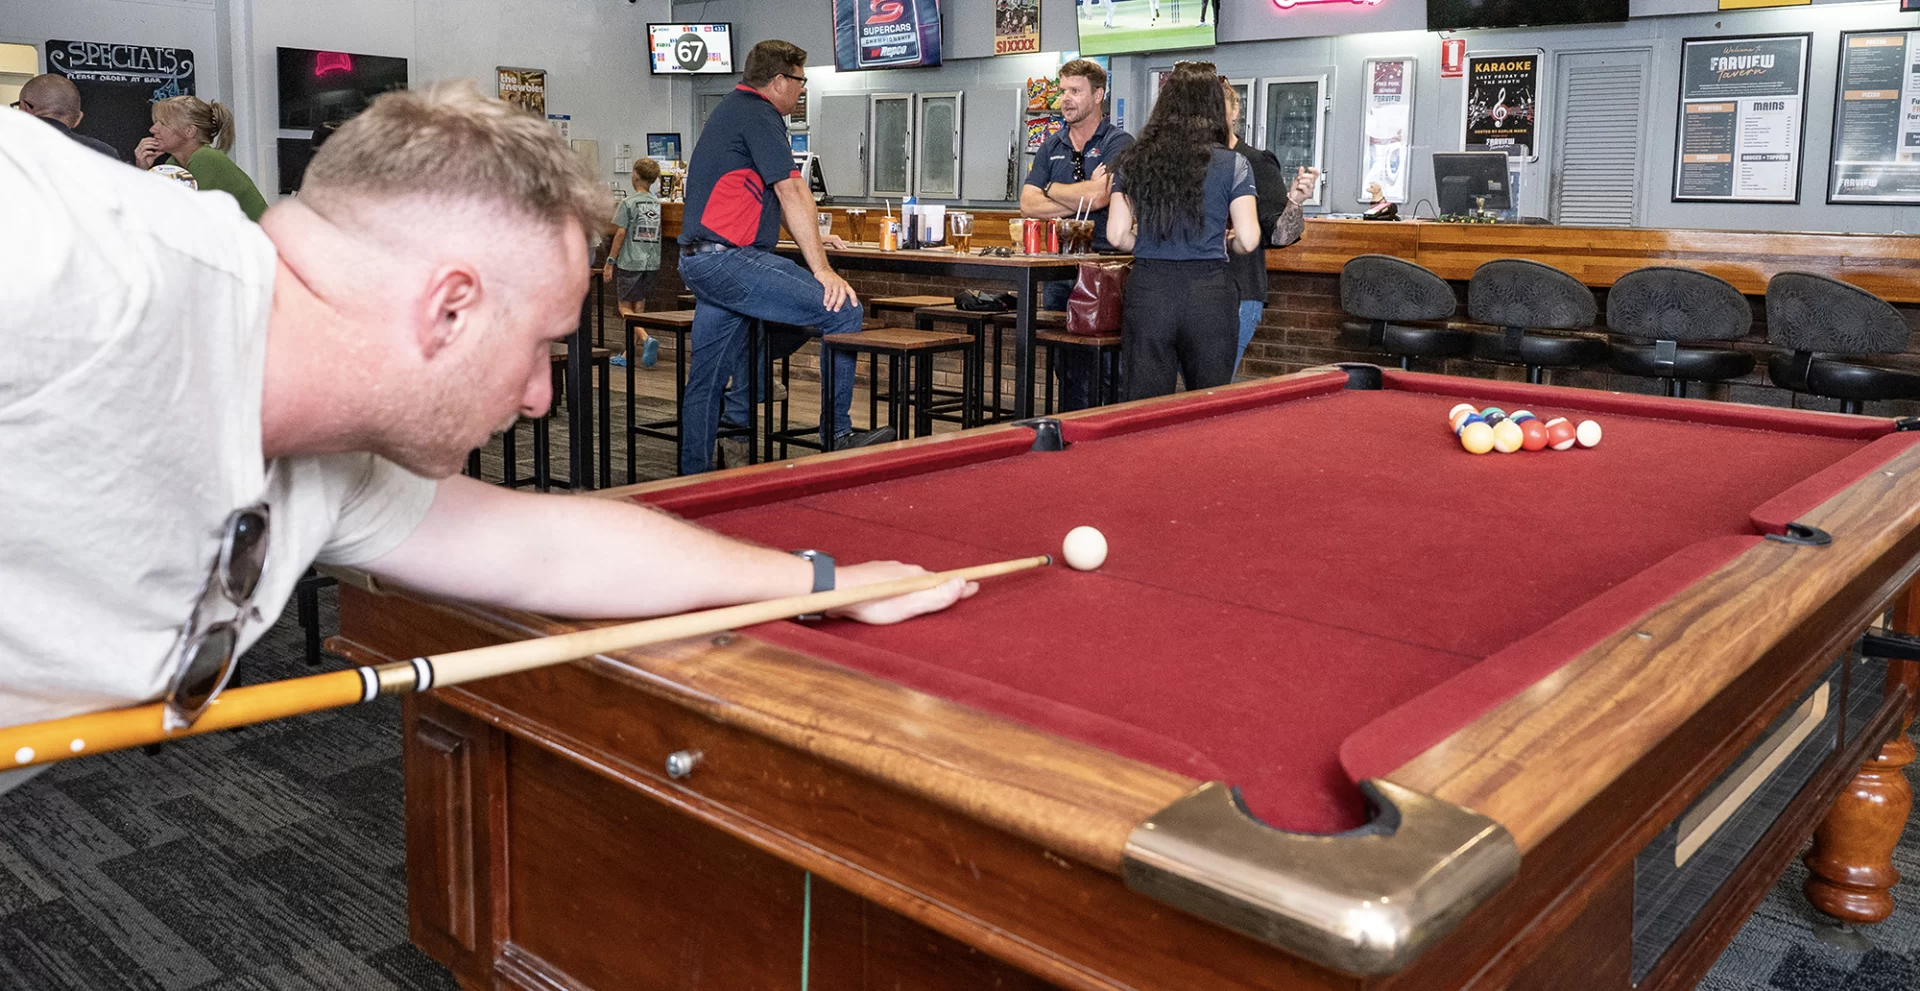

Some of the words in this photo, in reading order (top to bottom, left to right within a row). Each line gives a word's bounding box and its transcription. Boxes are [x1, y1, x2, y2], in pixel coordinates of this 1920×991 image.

[863, 23, 911, 36] SUPERCARS
[865, 34, 911, 44] CHAMPIONSHIP
[677, 41, 704, 63] 67
[880, 45, 907, 58] Repco
[996, 39, 1035, 53] SIXXXX
[1723, 45, 1754, 54] Welcome
[1755, 45, 1762, 53] to
[67, 41, 178, 74] SPECIALS
[1710, 54, 1775, 70] FARVIEW
[1475, 61, 1531, 73] KARAOKE
[500, 73, 517, 84] the
[1716, 68, 1766, 82] Tavern
[1753, 101, 1785, 111] MAINS
[1839, 178, 1878, 187] FARVIEW
